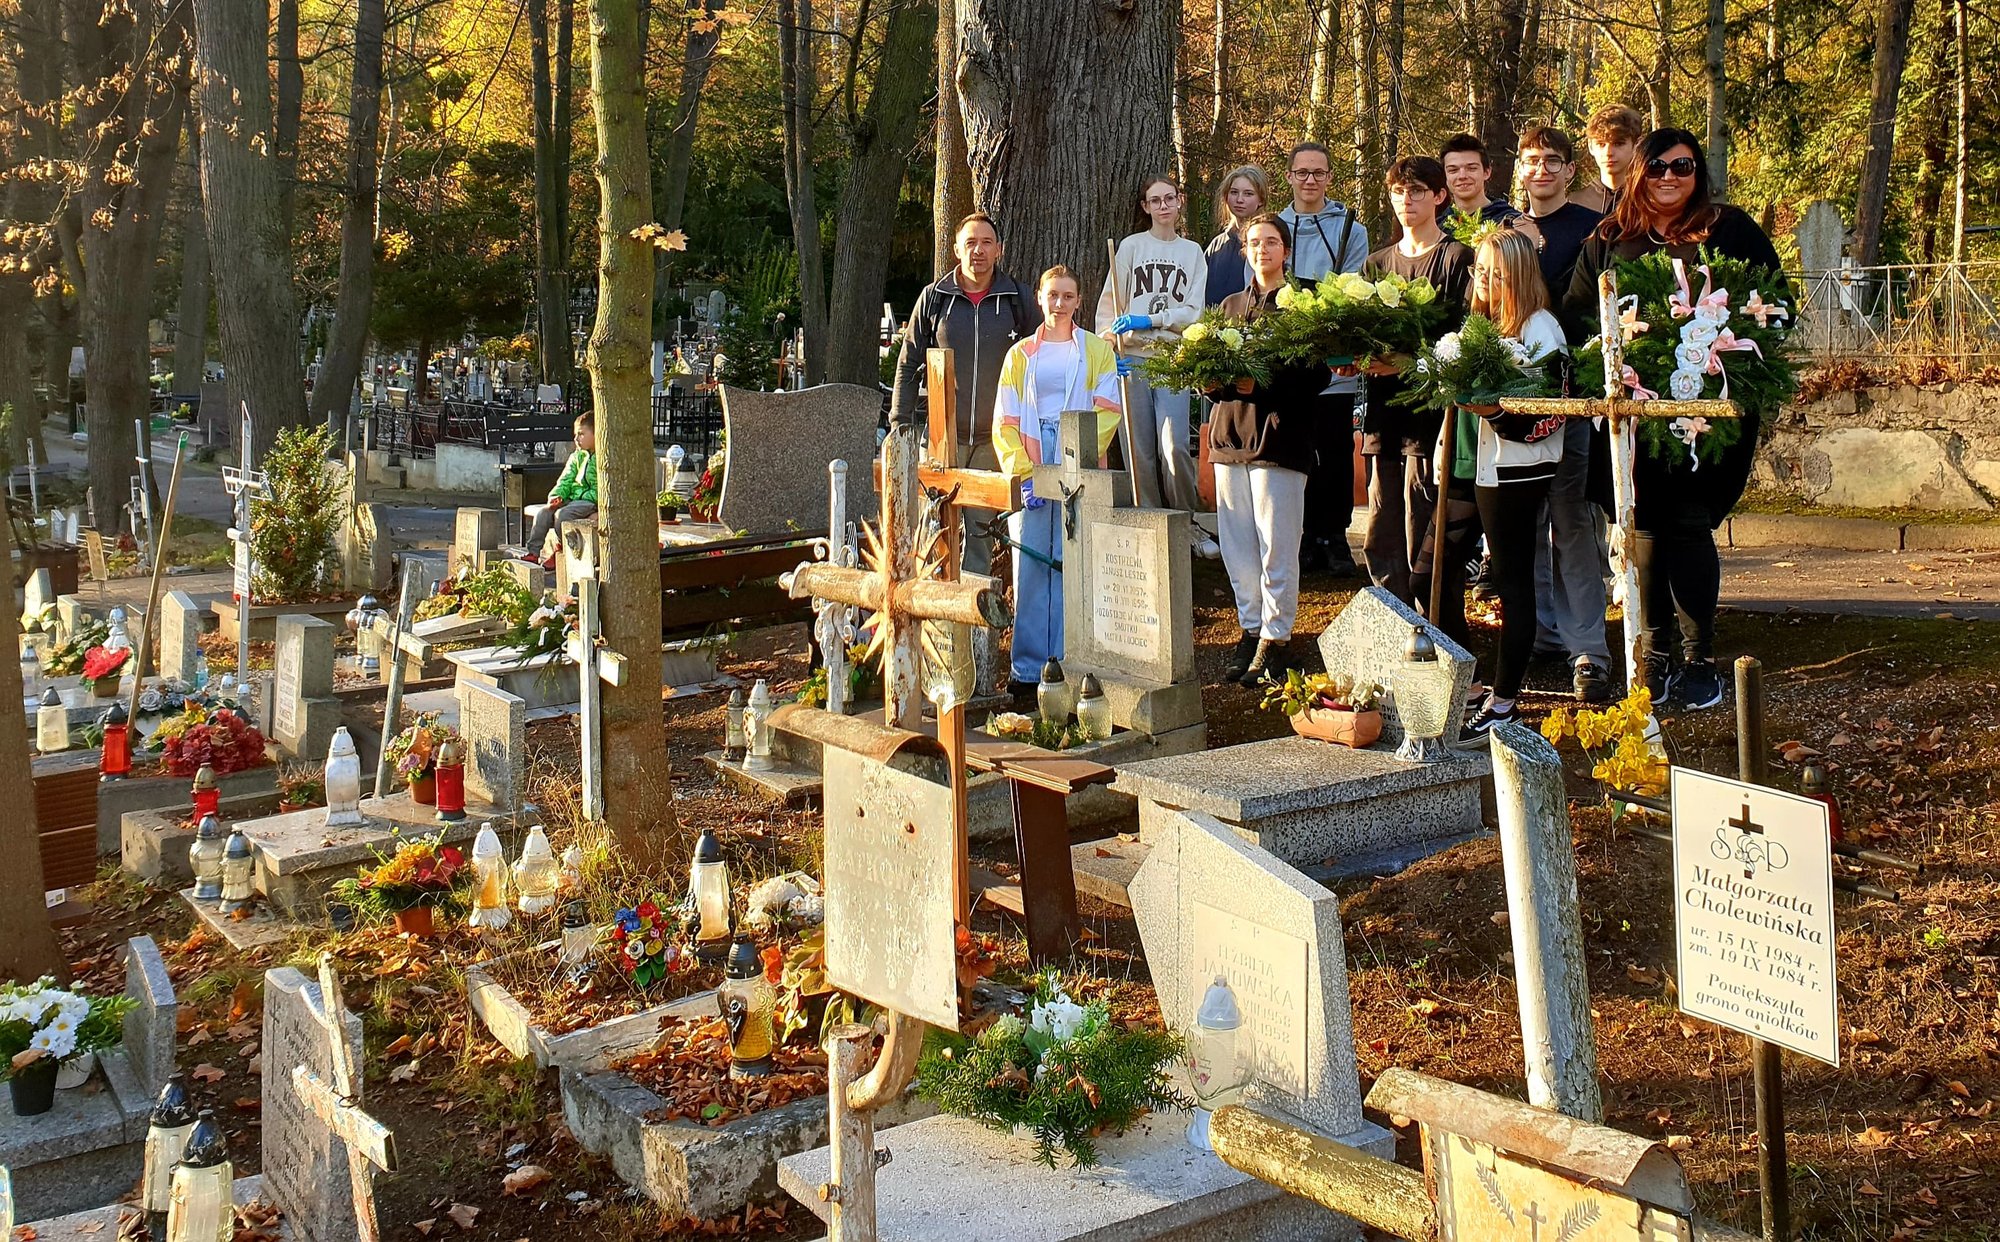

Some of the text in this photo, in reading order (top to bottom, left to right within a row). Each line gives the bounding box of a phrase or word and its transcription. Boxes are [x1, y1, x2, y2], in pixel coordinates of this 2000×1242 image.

[1133, 263, 1188, 303] NYC
[1691, 863, 1815, 917] Małgorzata
[1685, 887, 1824, 946] Cholewińska
[1688, 940, 1822, 993] zm. 19 IX 1984 r.
[1690, 925, 1819, 974] ur. 15 IX 1984 r.
[1695, 990, 1740, 1014] grono
